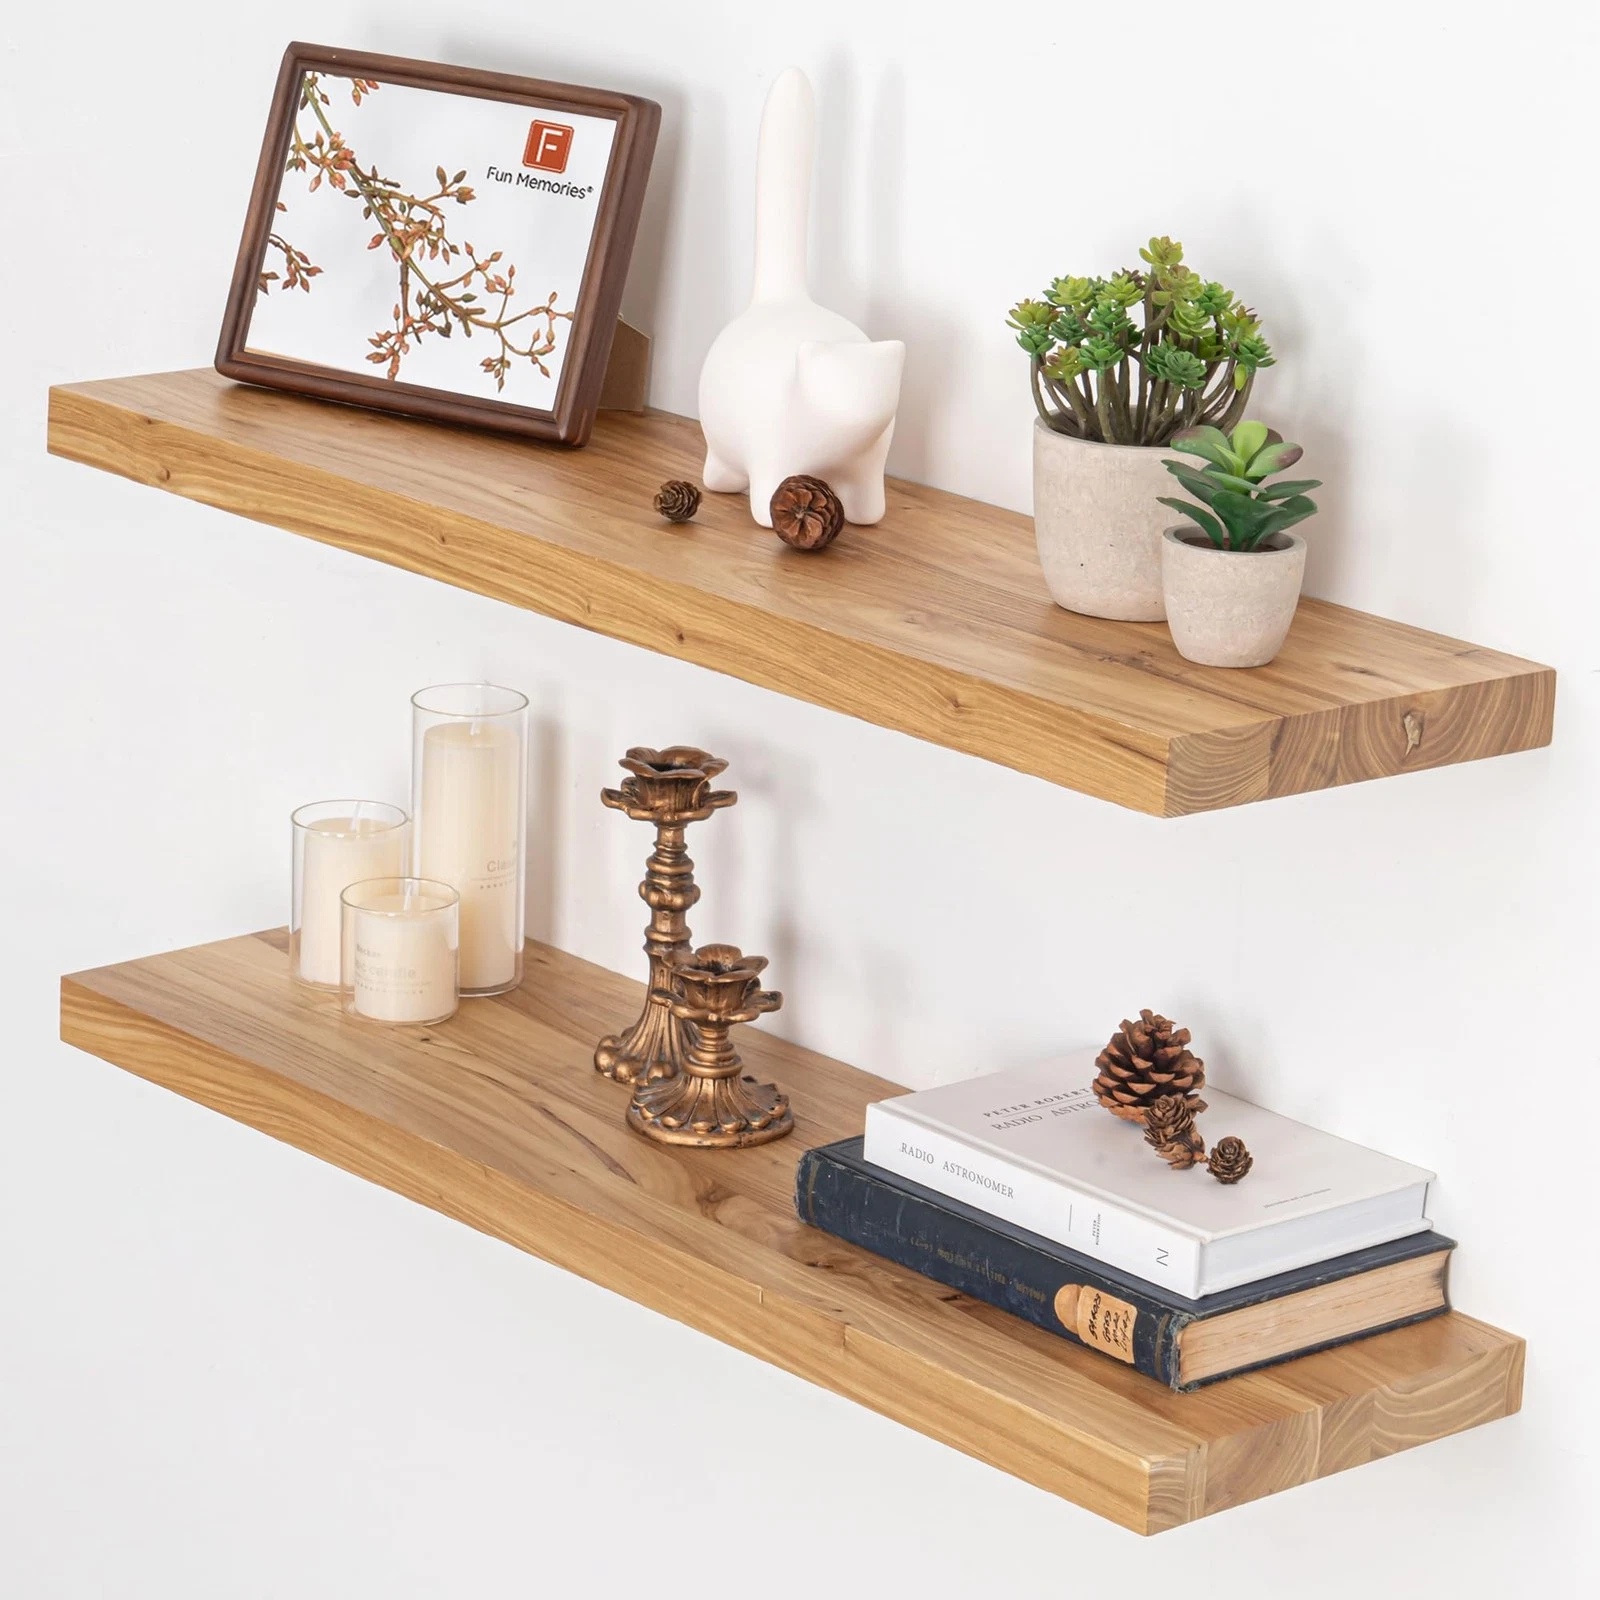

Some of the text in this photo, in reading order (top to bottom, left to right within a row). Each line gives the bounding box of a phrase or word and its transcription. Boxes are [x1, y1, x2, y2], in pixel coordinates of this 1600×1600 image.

[536, 128, 563, 162] F
[486, 166, 512, 184] Fun
[983, 1085, 1094, 1118] PETER ROBERT
[991, 1114, 1044, 1131] RADIO
[900, 1142, 1015, 1199] RADIO ASTRONOMER
